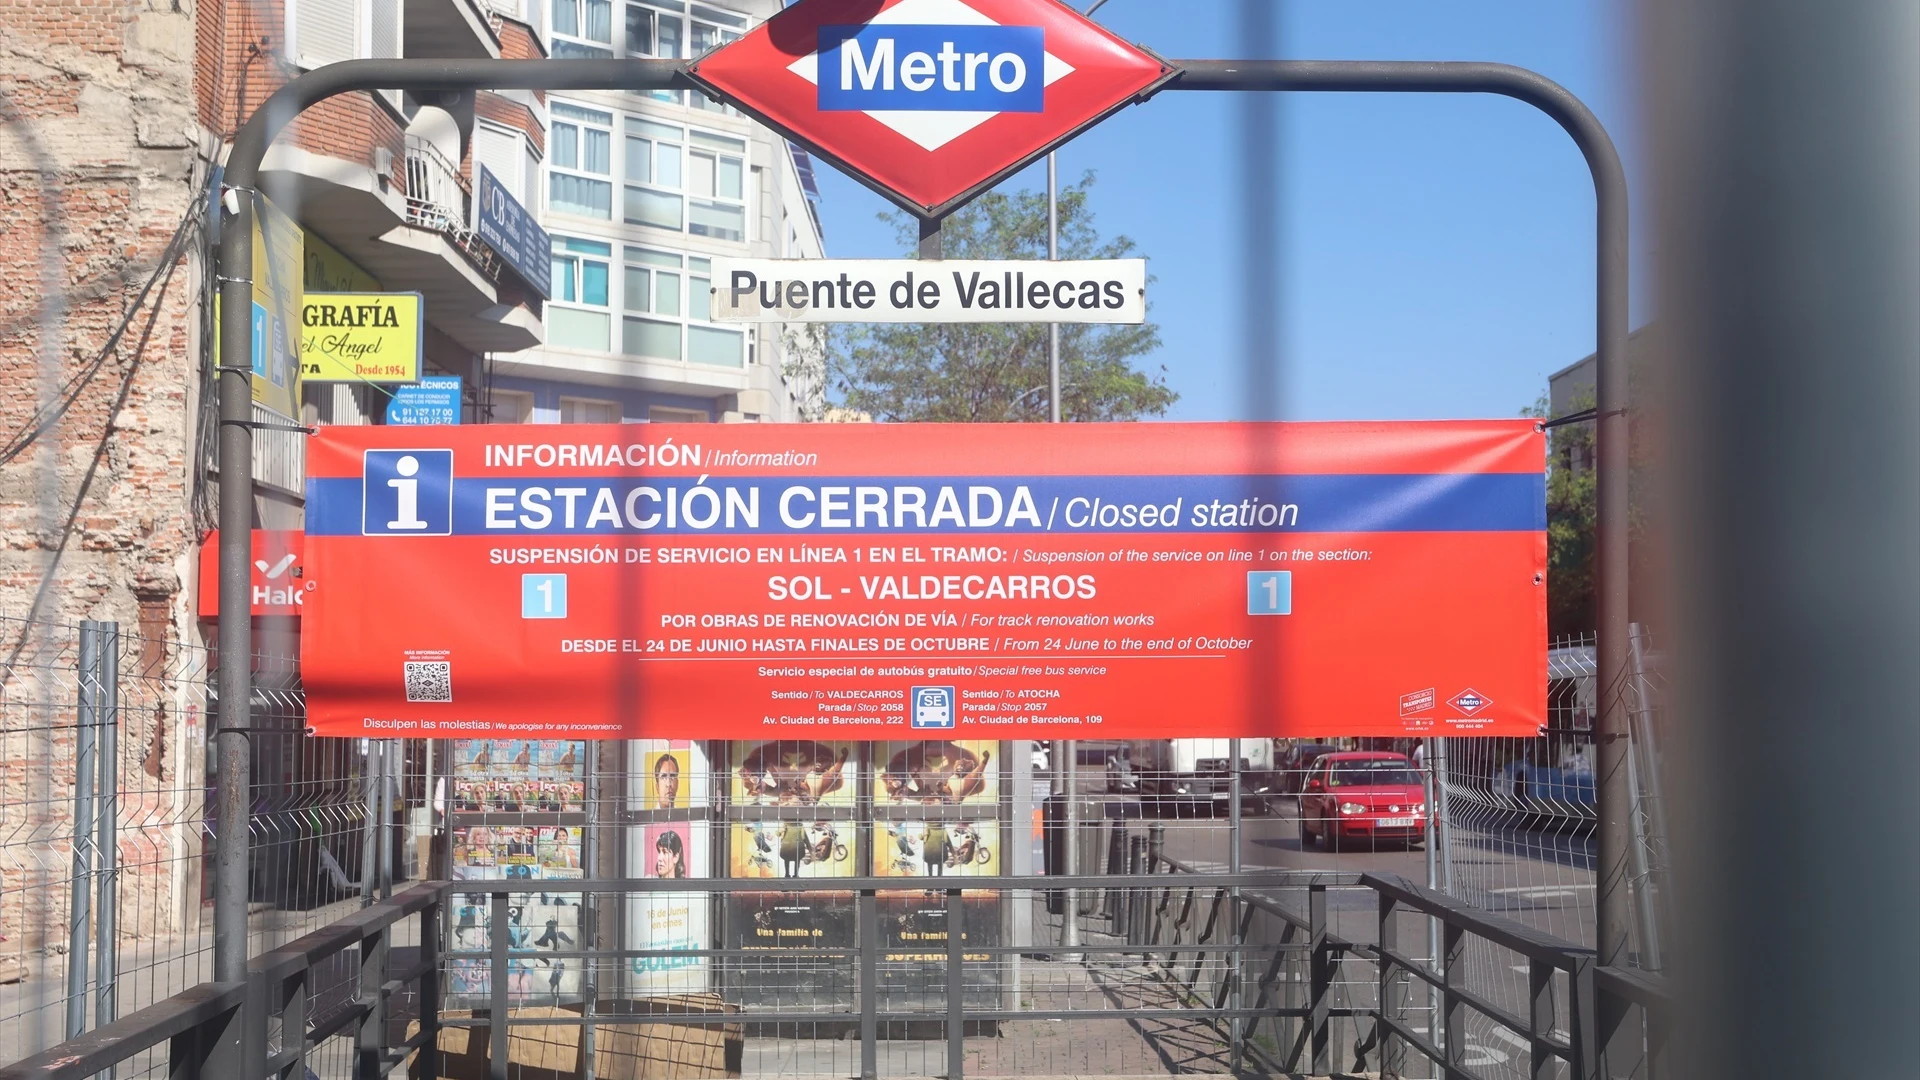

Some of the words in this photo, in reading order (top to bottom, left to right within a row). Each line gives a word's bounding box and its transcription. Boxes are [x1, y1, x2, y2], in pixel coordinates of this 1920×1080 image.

[841, 39, 1026, 92] Metro
[732, 271, 875, 309] Puente
[890, 272, 940, 309] de
[953, 272, 1124, 309] Vallecas
[256, 315, 263, 367] 1
[322, 327, 382, 360] Ángel
[356, 364, 383, 374] Desde
[385, 365, 405, 376] 1954
[402, 408, 412, 416] 91
[432, 408, 441, 416] 17
[486, 438, 700, 466] INFORMACIÓN
[714, 450, 817, 466] Information
[485, 474, 760, 529] ESTACIÓN
[778, 486, 1041, 528] CERRADA
[1065, 497, 1180, 528] Closed
[1191, 498, 1299, 527] station
[490, 544, 618, 564] SUSPENSIÓN
[626, 549, 651, 563] DE
[658, 548, 750, 563] SERVICIO
[758, 548, 782, 562] EN
[790, 544, 847, 562] LÍNEA
[854, 548, 860, 562] 1
[870, 548, 895, 562] EN
[903, 548, 925, 562] EL
[931, 547, 1006, 562] TRAMO:
[1023, 549, 1104, 564] Suspension
[1109, 549, 1123, 561] of
[1127, 549, 1148, 561] the
[1152, 549, 1202, 561] service
[1207, 552, 1224, 561] on
[1228, 549, 1252, 561] line
[1260, 550, 1264, 560] 1
[1270, 552, 1287, 560] on
[1292, 549, 1313, 560] the
[1318, 549, 1372, 560] section:
[769, 576, 831, 600] SOL
[860, 575, 1096, 599] VALDECARROS
[1262, 577, 1277, 609] 1
[537, 580, 552, 612] 1
[662, 615, 695, 627] POR
[701, 615, 758, 627] OBRAS
[764, 615, 785, 627] DE
[791, 611, 899, 627] RENOVACIÓN
[905, 614, 926, 626] DE
[931, 610, 957, 626] VÍA
[971, 614, 994, 626] For
[998, 614, 1032, 626] track
[1037, 614, 1109, 626] renovation
[1114, 614, 1154, 625] works
[562, 640, 616, 652] DESDE
[623, 640, 642, 651] EL
[647, 640, 664, 652] 24
[670, 640, 691, 651] DE
[697, 639, 746, 652] JUNIO
[753, 639, 806, 651] HASTA
[812, 638, 878, 651] FINALES
[885, 639, 905, 650] DE
[911, 638, 989, 650] OCTUBRE
[1004, 638, 1039, 650] From
[1044, 638, 1060, 650] 24
[1065, 638, 1099, 650] June
[1104, 639, 1116, 649] to
[1121, 638, 1142, 649] the
[1147, 638, 1174, 649] end
[1178, 637, 1192, 649] of
[1196, 637, 1253, 649] October
[759, 667, 805, 676] Servicio
[809, 667, 856, 678] especial
[860, 667, 874, 675] de
[878, 666, 924, 675] autobús
[1022, 666, 1042, 675] free
[1045, 666, 1064, 675] bus
[1068, 666, 1106, 674] service
[923, 694, 943, 707] SE
[1018, 690, 1060, 698] ATOCHA
[364, 717, 417, 731] Disculpen
[421, 719, 436, 729] las
[508, 722, 543, 732] apologise
[555, 724, 570, 732] any
[570, 723, 622, 731] inconvenience
[763, 716, 777, 724] Av.
[780, 716, 814, 724] Ciudad
[833, 716, 883, 724] Barcelona,
[887, 716, 903, 724] 222
[962, 716, 976, 724] Av.
[979, 716, 1017, 724] Ciudad
[1020, 716, 1029, 724] de
[1031, 715, 1083, 725] Barcelona,
[1085, 716, 1103, 724] 109
[756, 928, 774, 937] Una
[777, 928, 809, 937] familia
[811, 928, 824, 937] de
[900, 932, 918, 940] Una
[921, 931, 949, 940] famili
